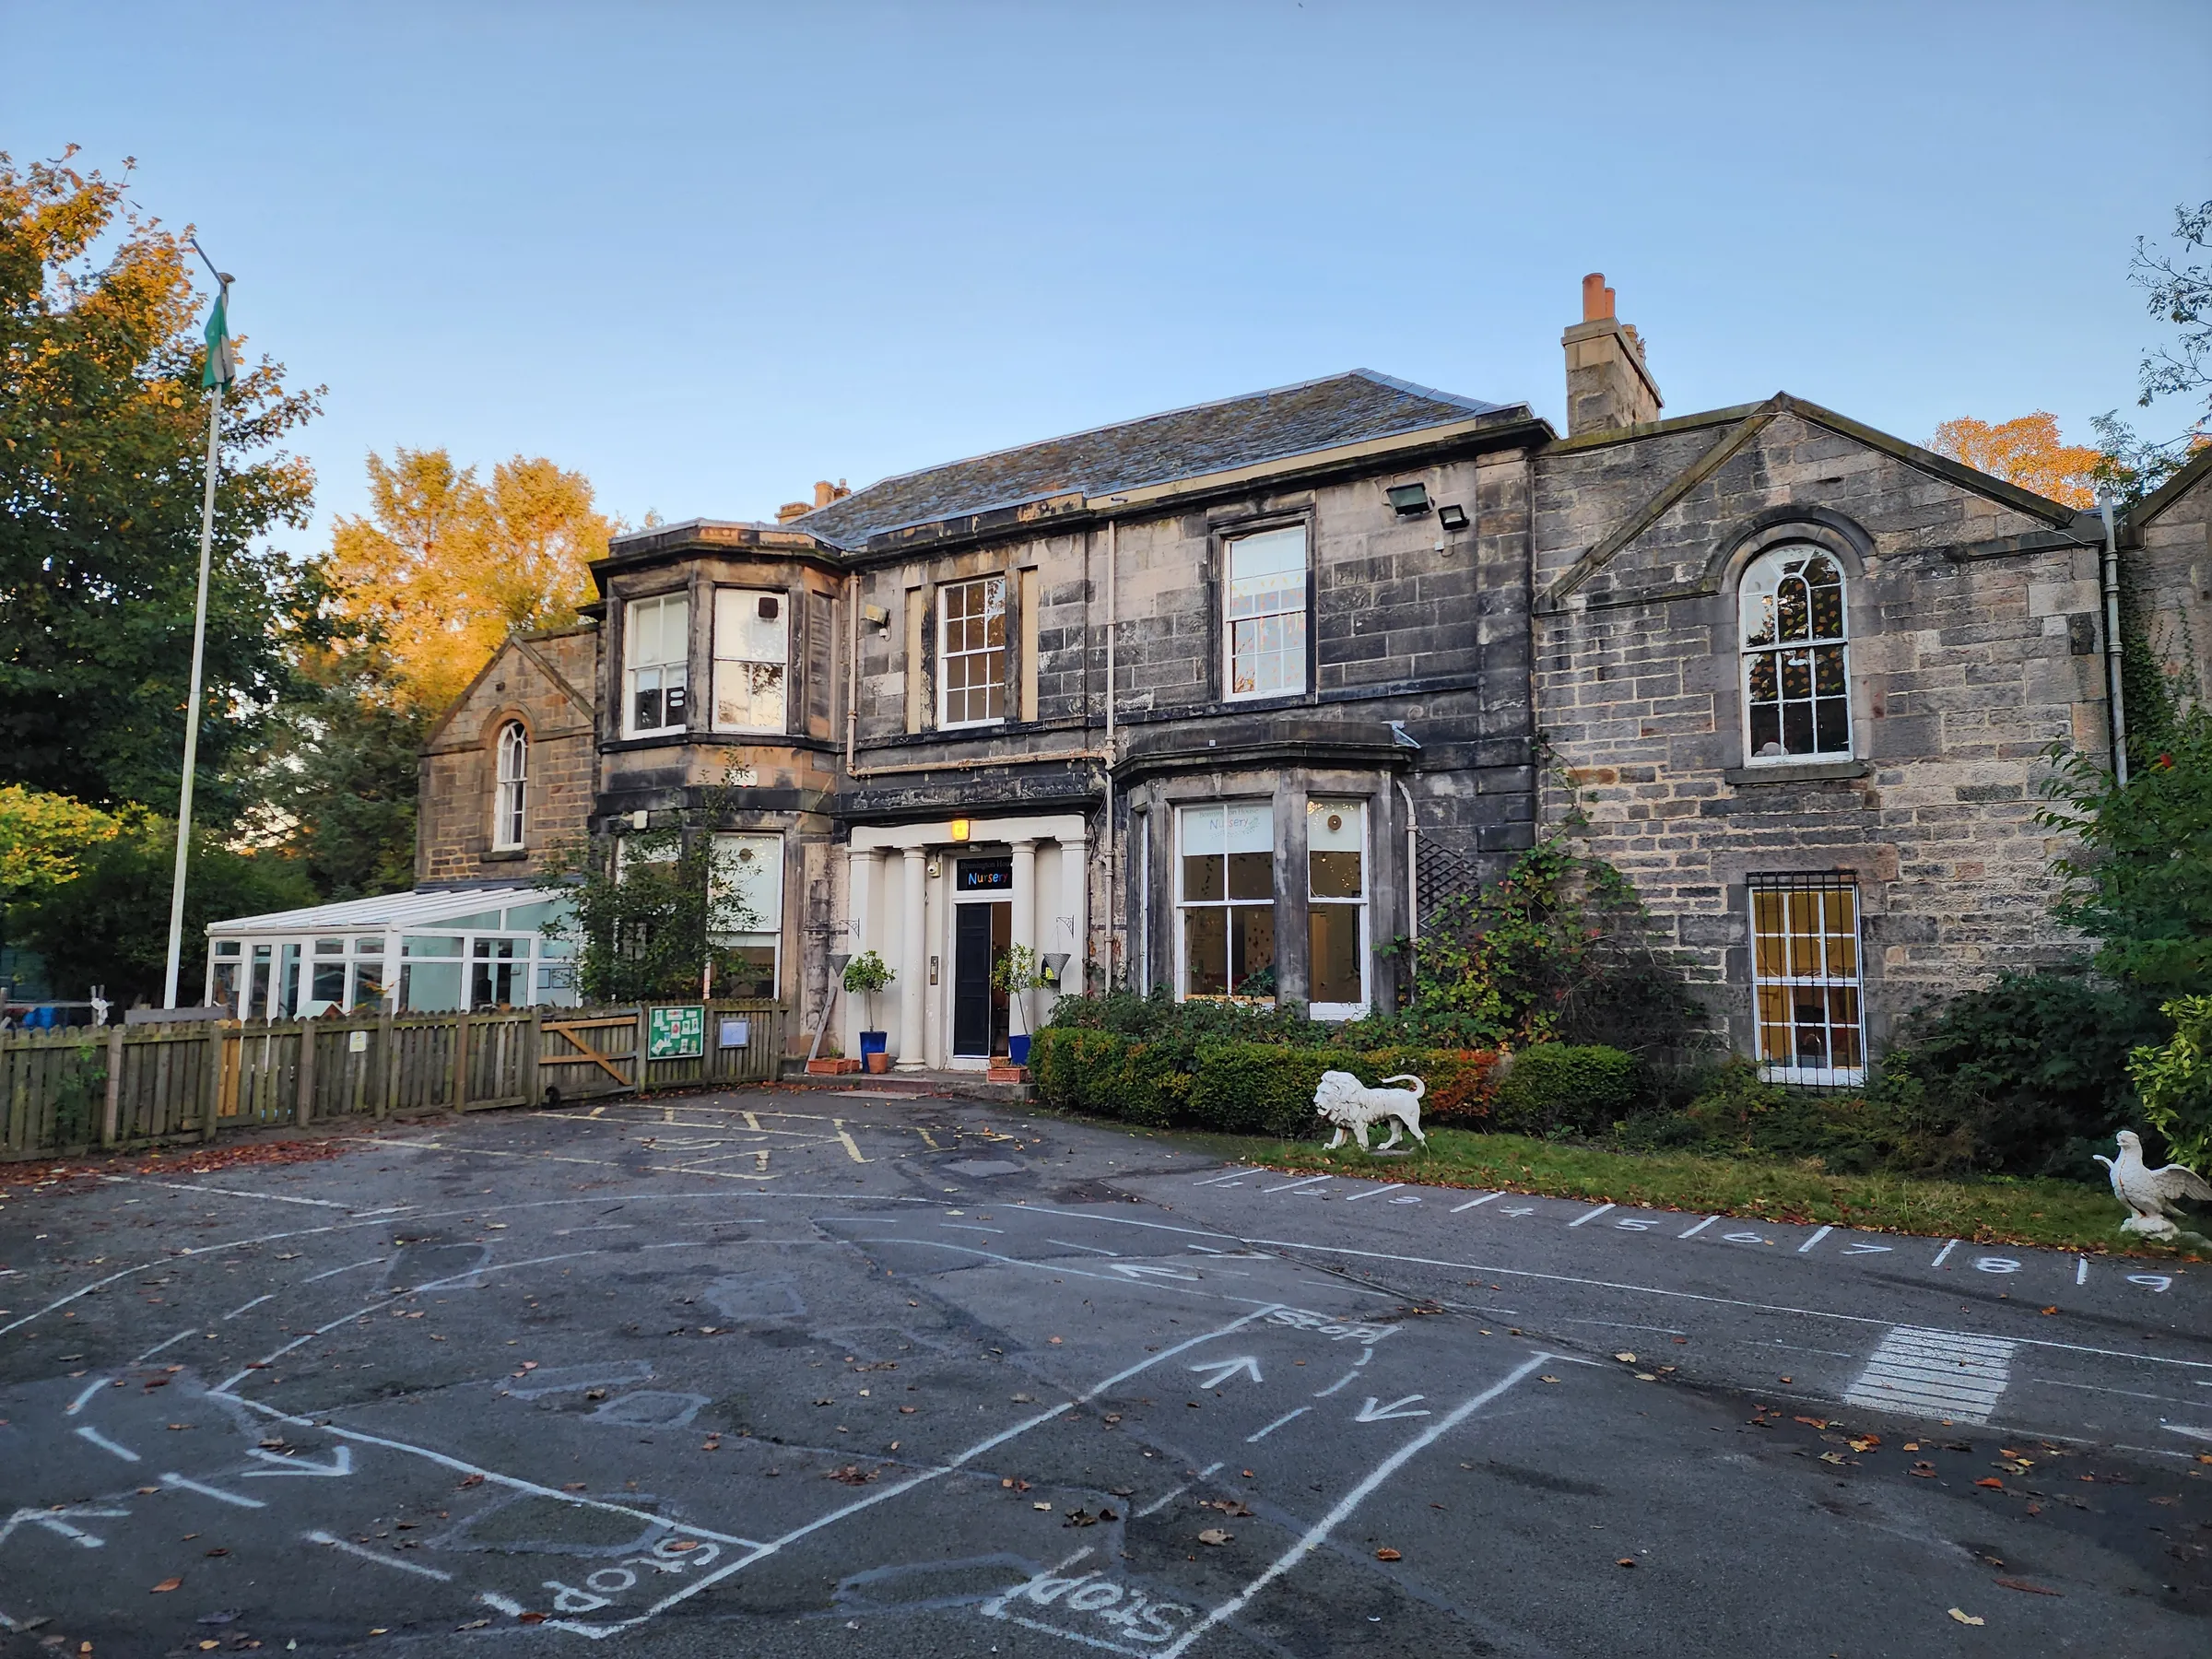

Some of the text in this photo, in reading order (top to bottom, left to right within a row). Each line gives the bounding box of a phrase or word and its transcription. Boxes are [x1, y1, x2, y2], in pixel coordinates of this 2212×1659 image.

[1199, 809, 1237, 818] Bonningon
[1210, 818, 1248, 830] Nusery
[968, 873, 1007, 885] Nursery
[1387, 1195, 1422, 1205] 3
[1615, 1218, 1659, 1231] 5
[1722, 1231, 1763, 1243] 6
[1842, 1242, 1894, 1255] 7
[1975, 1257, 2022, 1273] 8
[2126, 1275, 2172, 1293] 9
[1264, 1310, 1377, 1341] Stop
[541, 1537, 721, 1613] Stop
[1029, 1570, 1194, 1642] Stop
